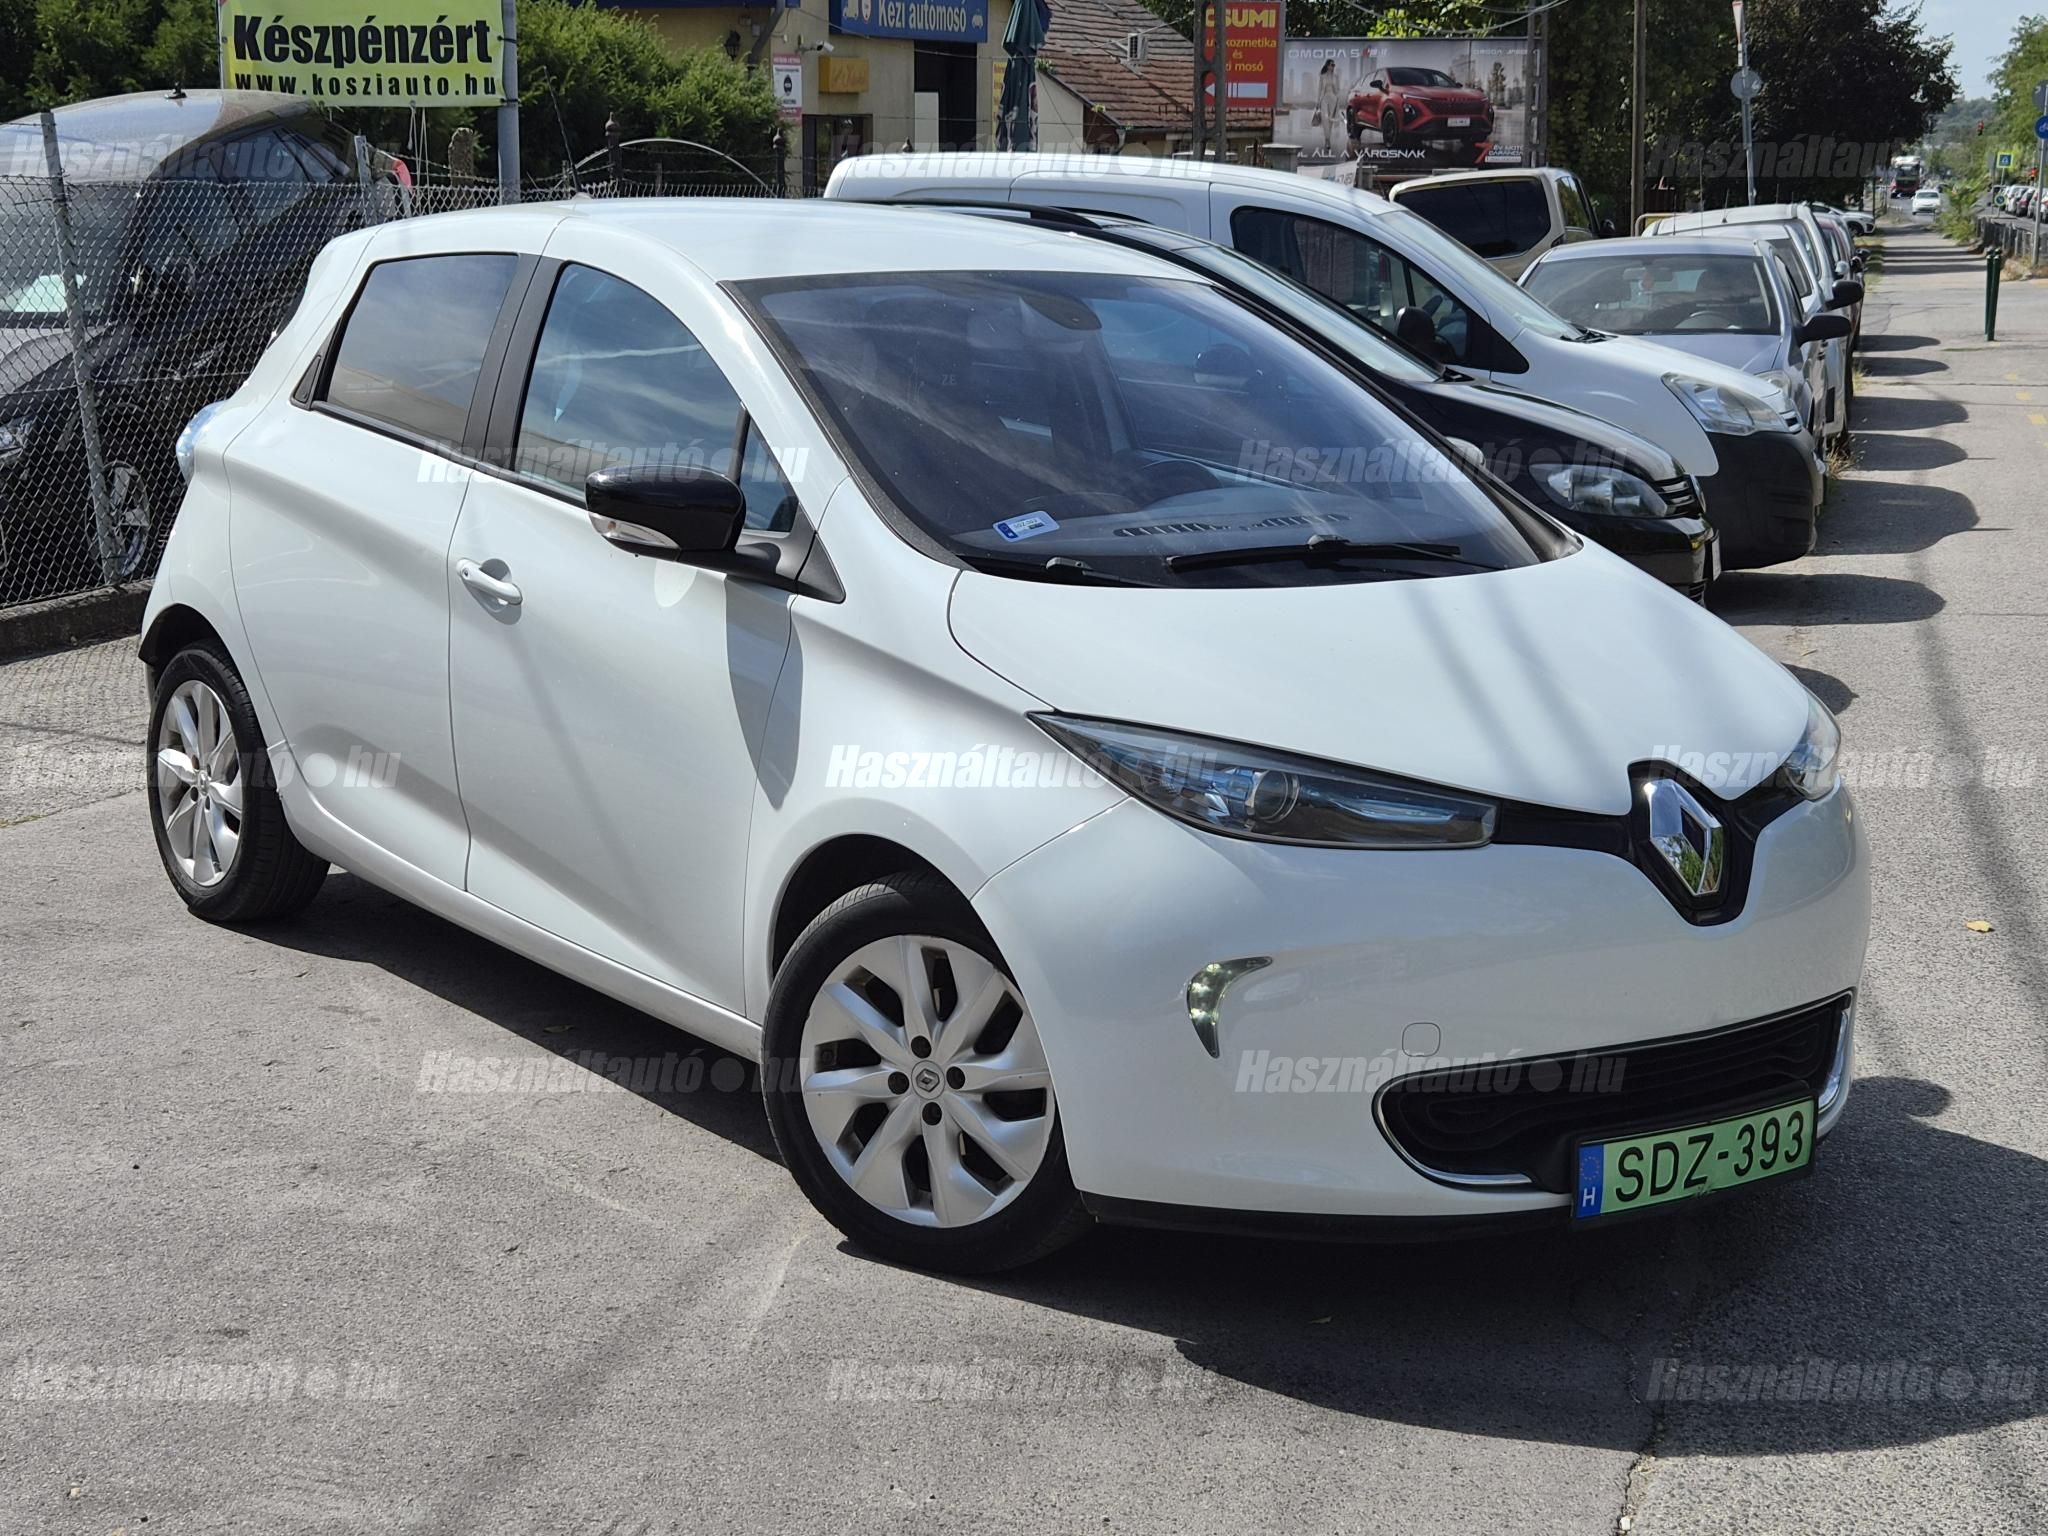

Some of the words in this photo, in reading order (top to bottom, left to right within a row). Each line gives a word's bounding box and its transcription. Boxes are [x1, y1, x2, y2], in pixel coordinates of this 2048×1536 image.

[233, 15, 493, 69] Készpénzért
[235, 73, 497, 96] www.kosziauto.hu
[1354, 147, 1425, 159] VÁROSNAK
[1582, 1187, 1596, 1208] H
[1615, 1110, 1805, 1203] SDZ-393
